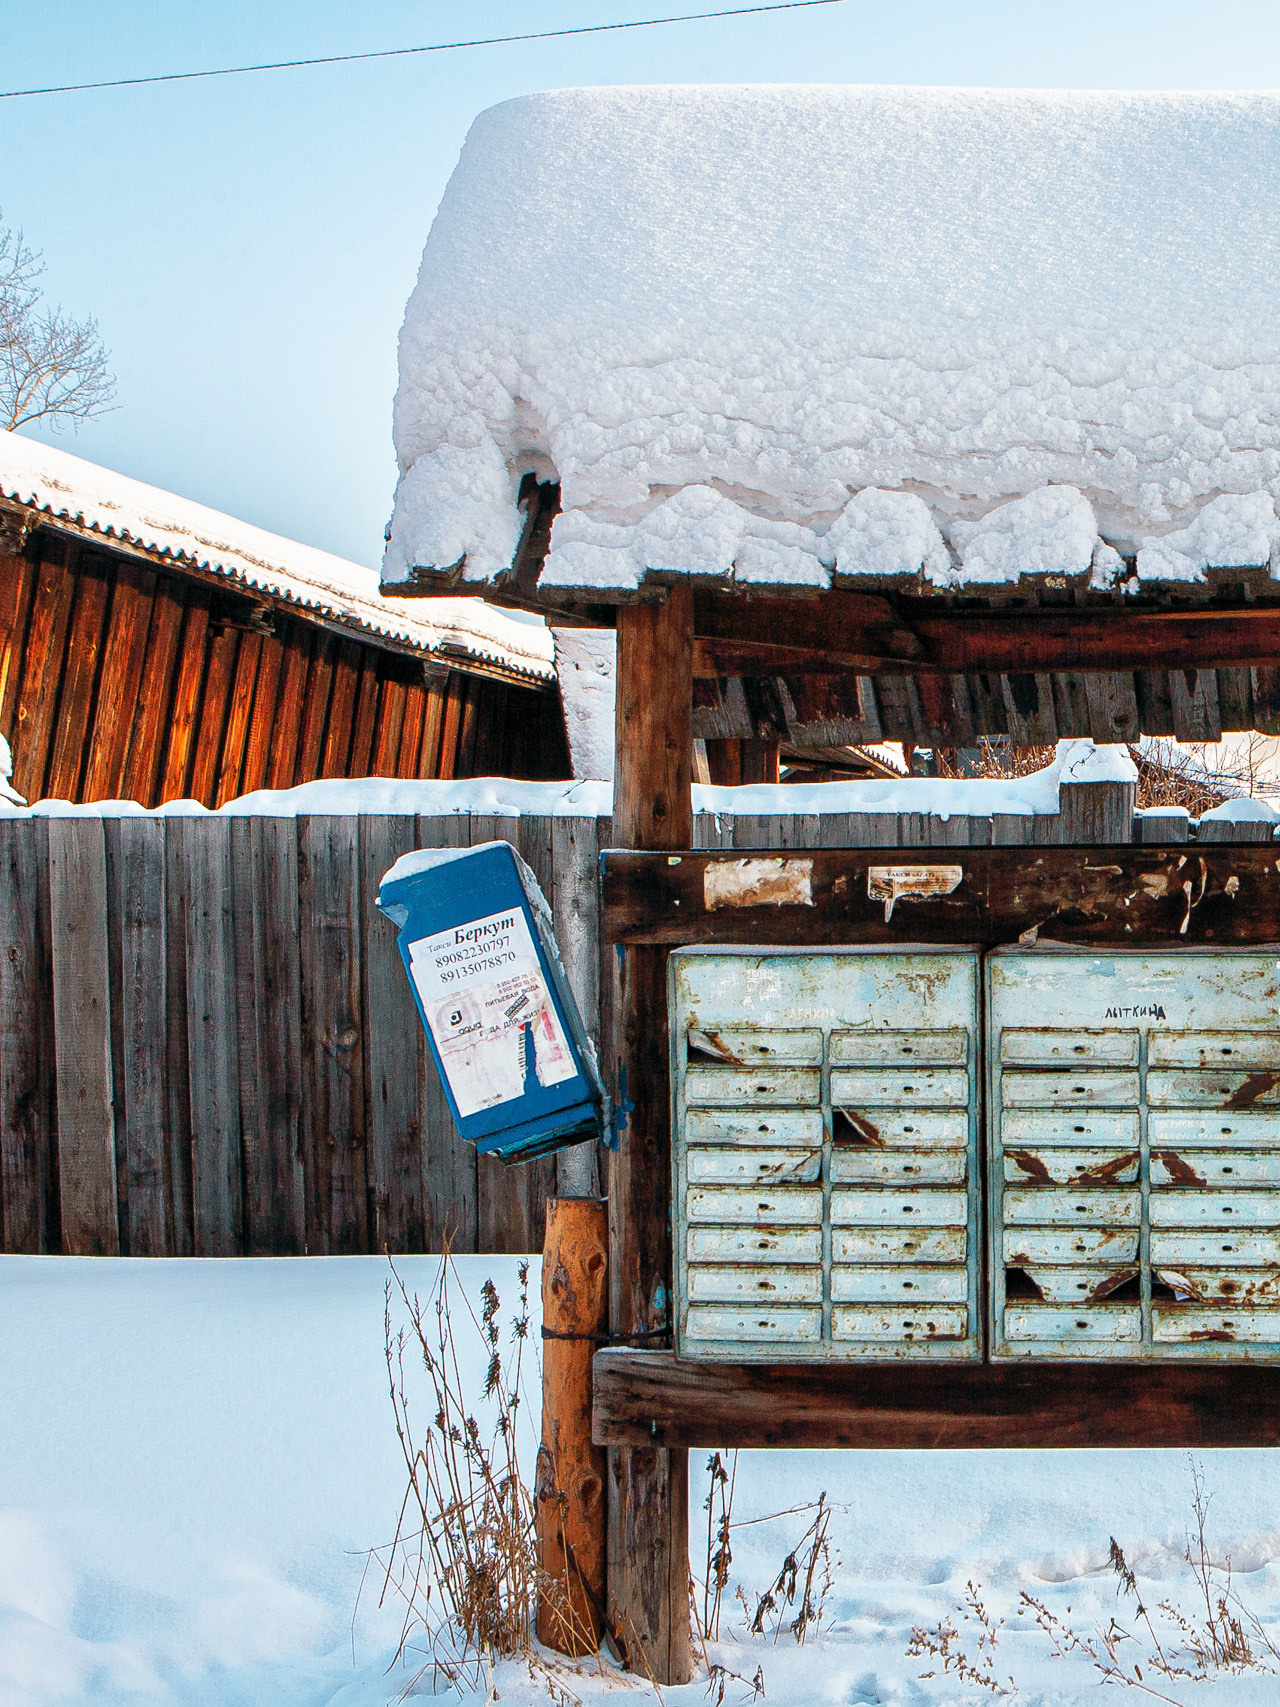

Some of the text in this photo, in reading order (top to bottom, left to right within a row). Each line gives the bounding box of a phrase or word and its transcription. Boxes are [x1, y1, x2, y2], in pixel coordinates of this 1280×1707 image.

[427, 917, 516, 954] Такси Беркут
[435, 935, 510, 968] 89082230797
[440, 951, 516, 984] 89135078870
[484, 984, 540, 1008] ПИТЬЕВАЯ ВОДА
[458, 1022, 482, 1035] aqua
[503, 1018, 520, 1029] ДЛЯ
